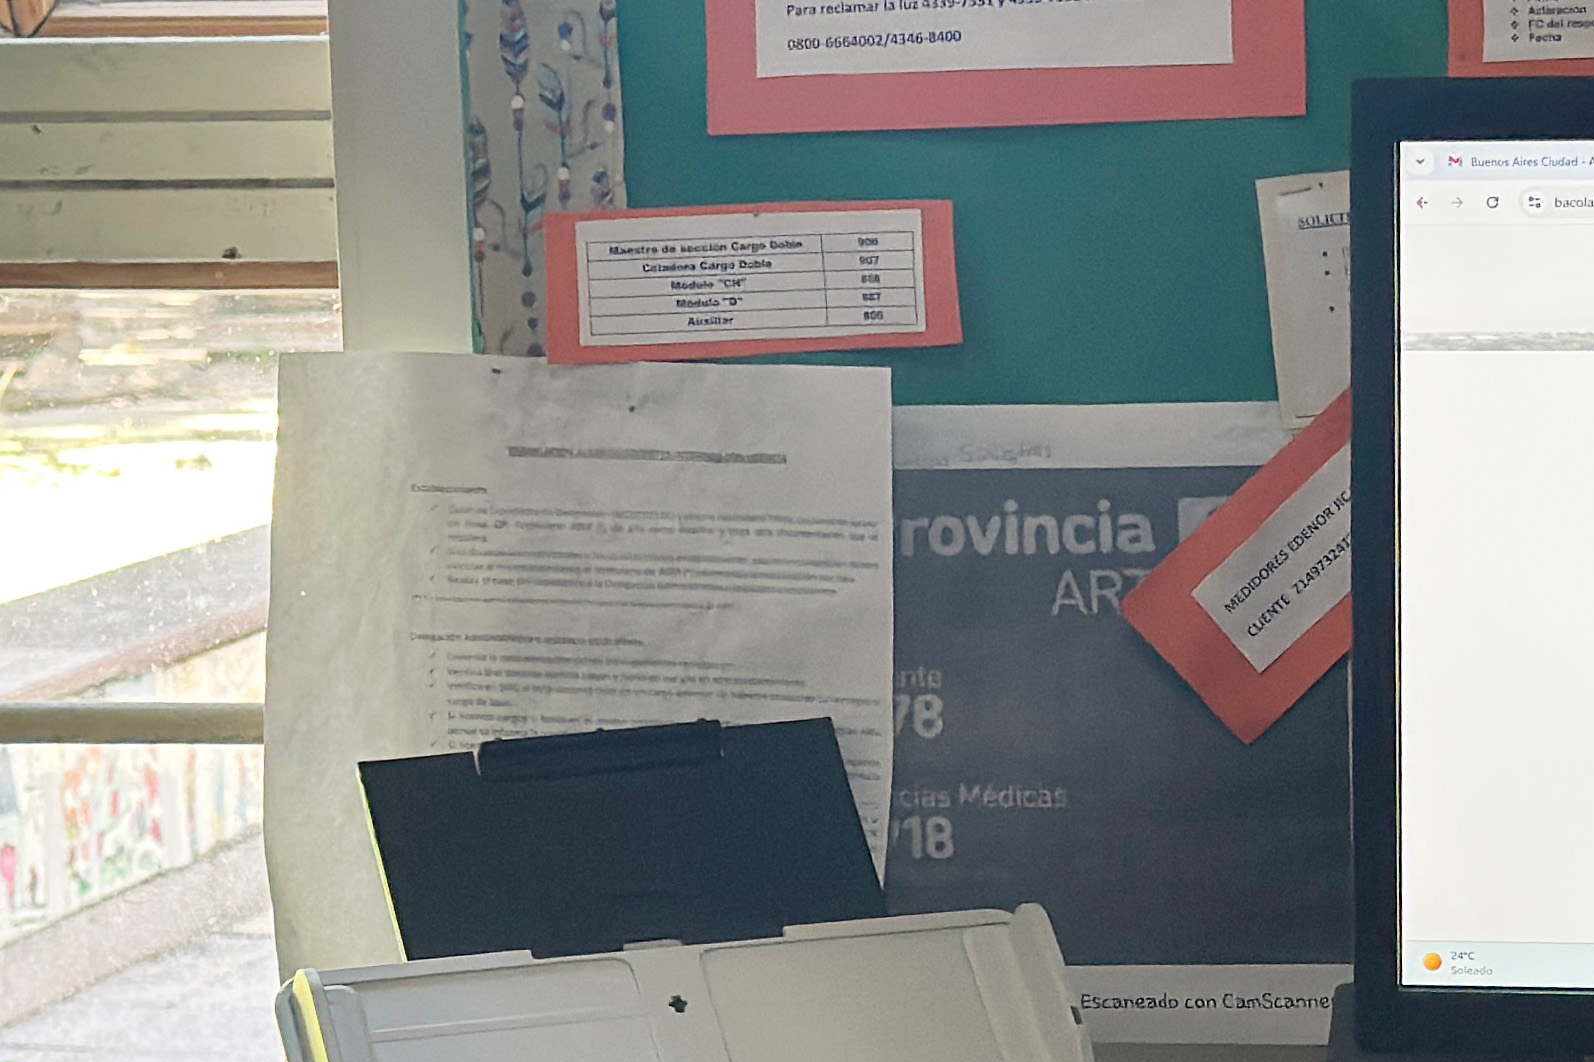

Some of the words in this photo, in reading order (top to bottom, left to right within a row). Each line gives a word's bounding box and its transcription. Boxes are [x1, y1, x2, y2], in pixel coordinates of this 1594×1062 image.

[786, 4, 817, 17] Para
[820, 1, 879, 15] reclamar
[883, 0, 896, 12] la
[899, 0, 919, 11] luz
[1471, 156, 1510, 167] Buenos
[1511, 156, 1539, 167] Aires
[1540, 156, 1579, 167] Ciudad
[901, 499, 1156, 556] rovincia
[1450, 965, 1494, 976] Soleado
[1080, 992, 1179, 1010] Escaneado
[1184, 996, 1217, 1009] con
[1222, 993, 1333, 1010] CamScanne
